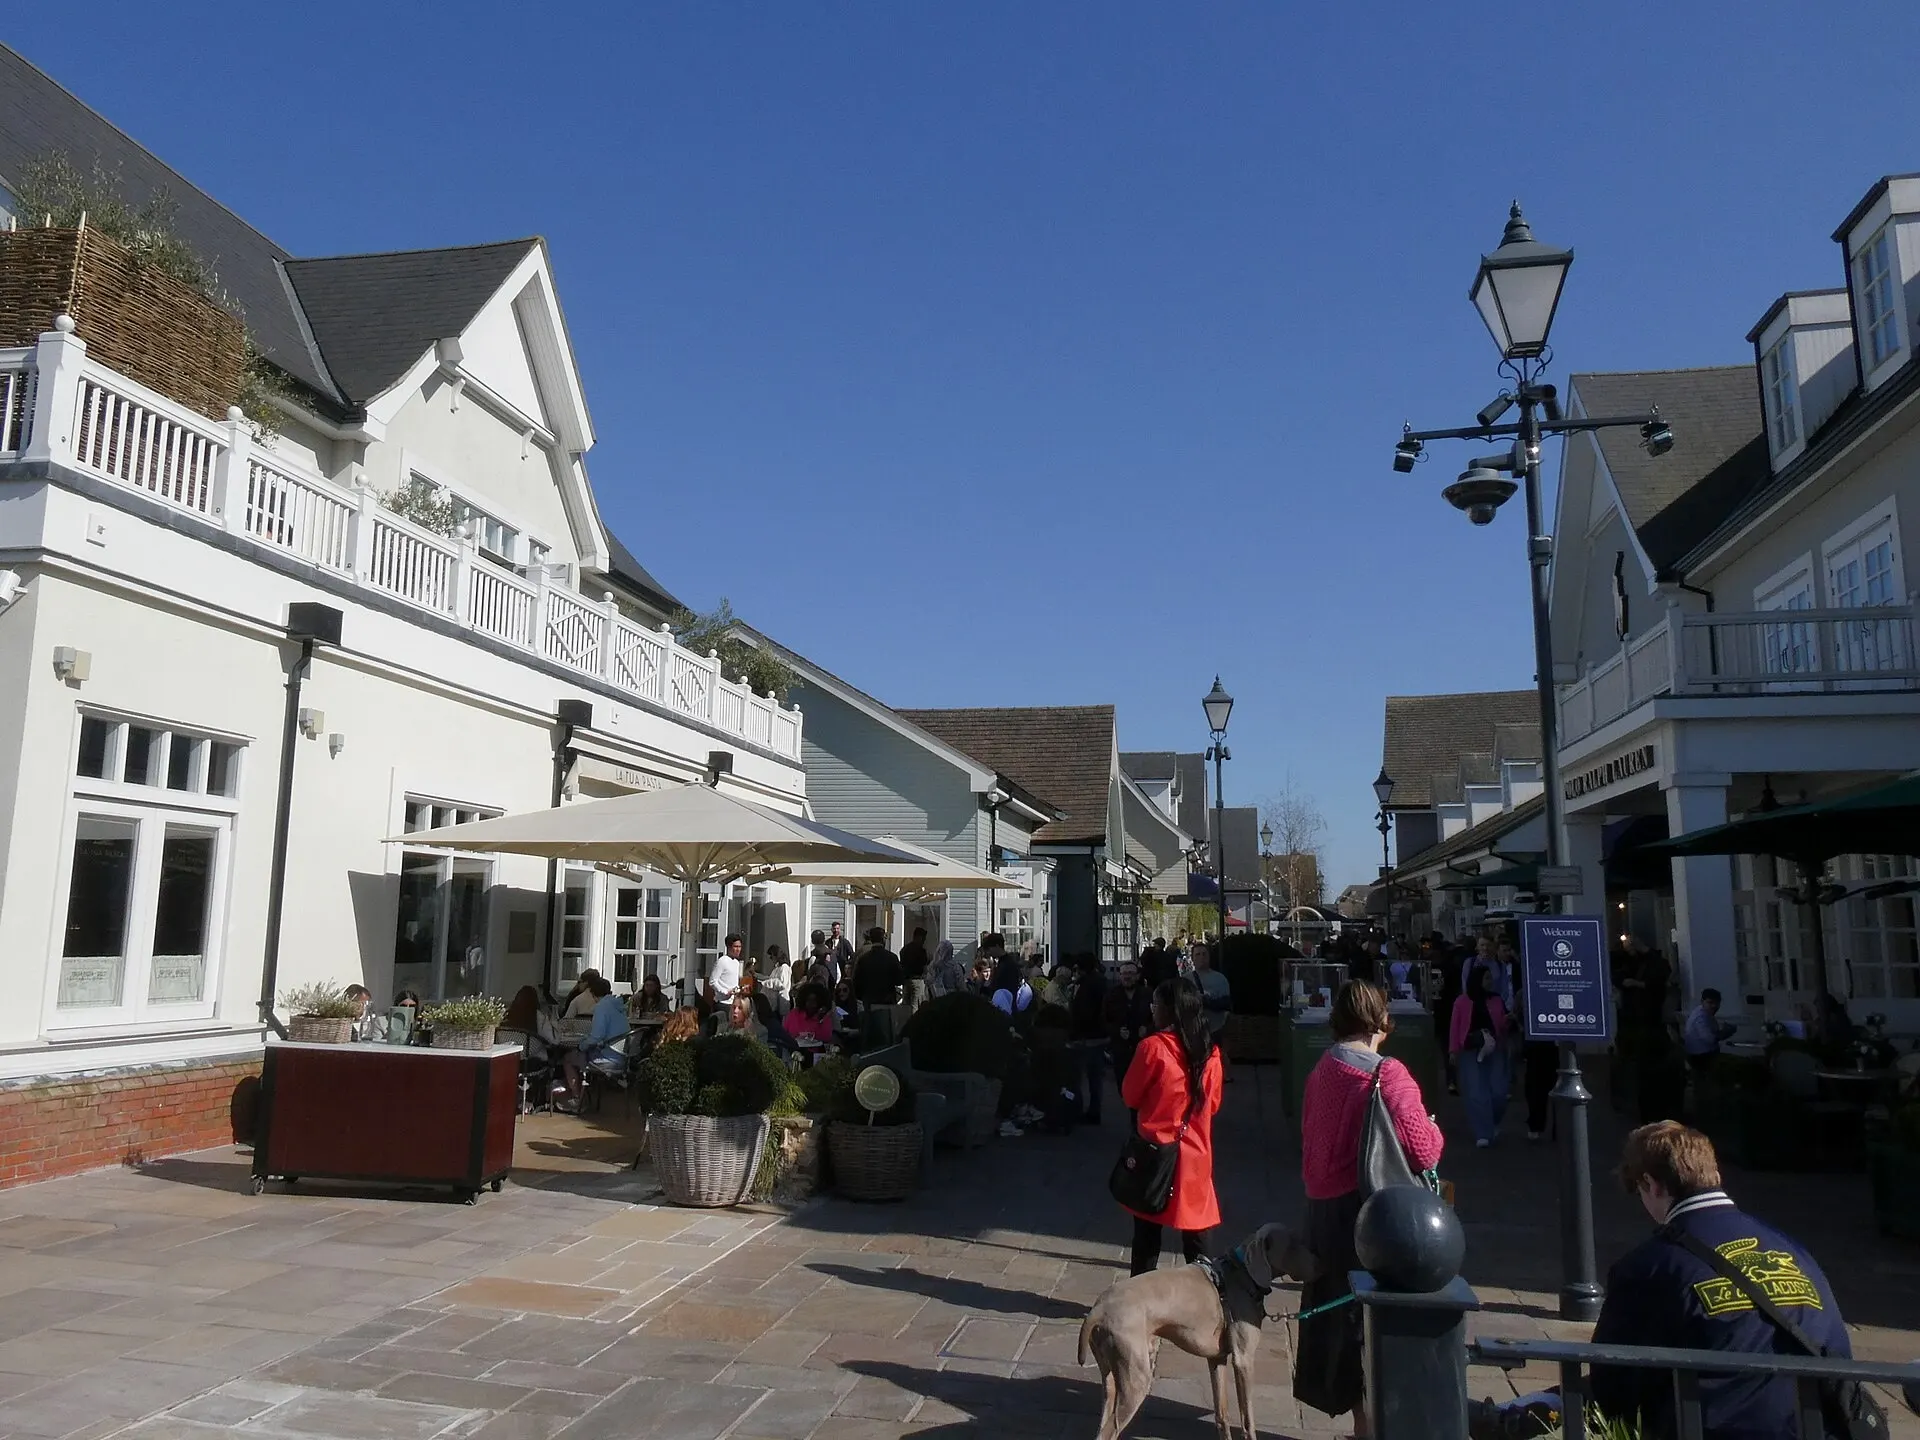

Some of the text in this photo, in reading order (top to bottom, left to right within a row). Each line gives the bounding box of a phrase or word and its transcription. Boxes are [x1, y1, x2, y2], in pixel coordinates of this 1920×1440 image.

[1582, 761, 1610, 794] RALPH
[1611, 744, 1654, 781] LAUREN
[615, 767, 662, 790] LA TUA PASTA
[1541, 927, 1582, 937] Welcome
[1545, 960, 1582, 968] BICESTER
[1546, 968, 1582, 976] VILLAGE
[1713, 1285, 1732, 1302] Le
[1762, 1280, 1815, 1298] LACOSTE
